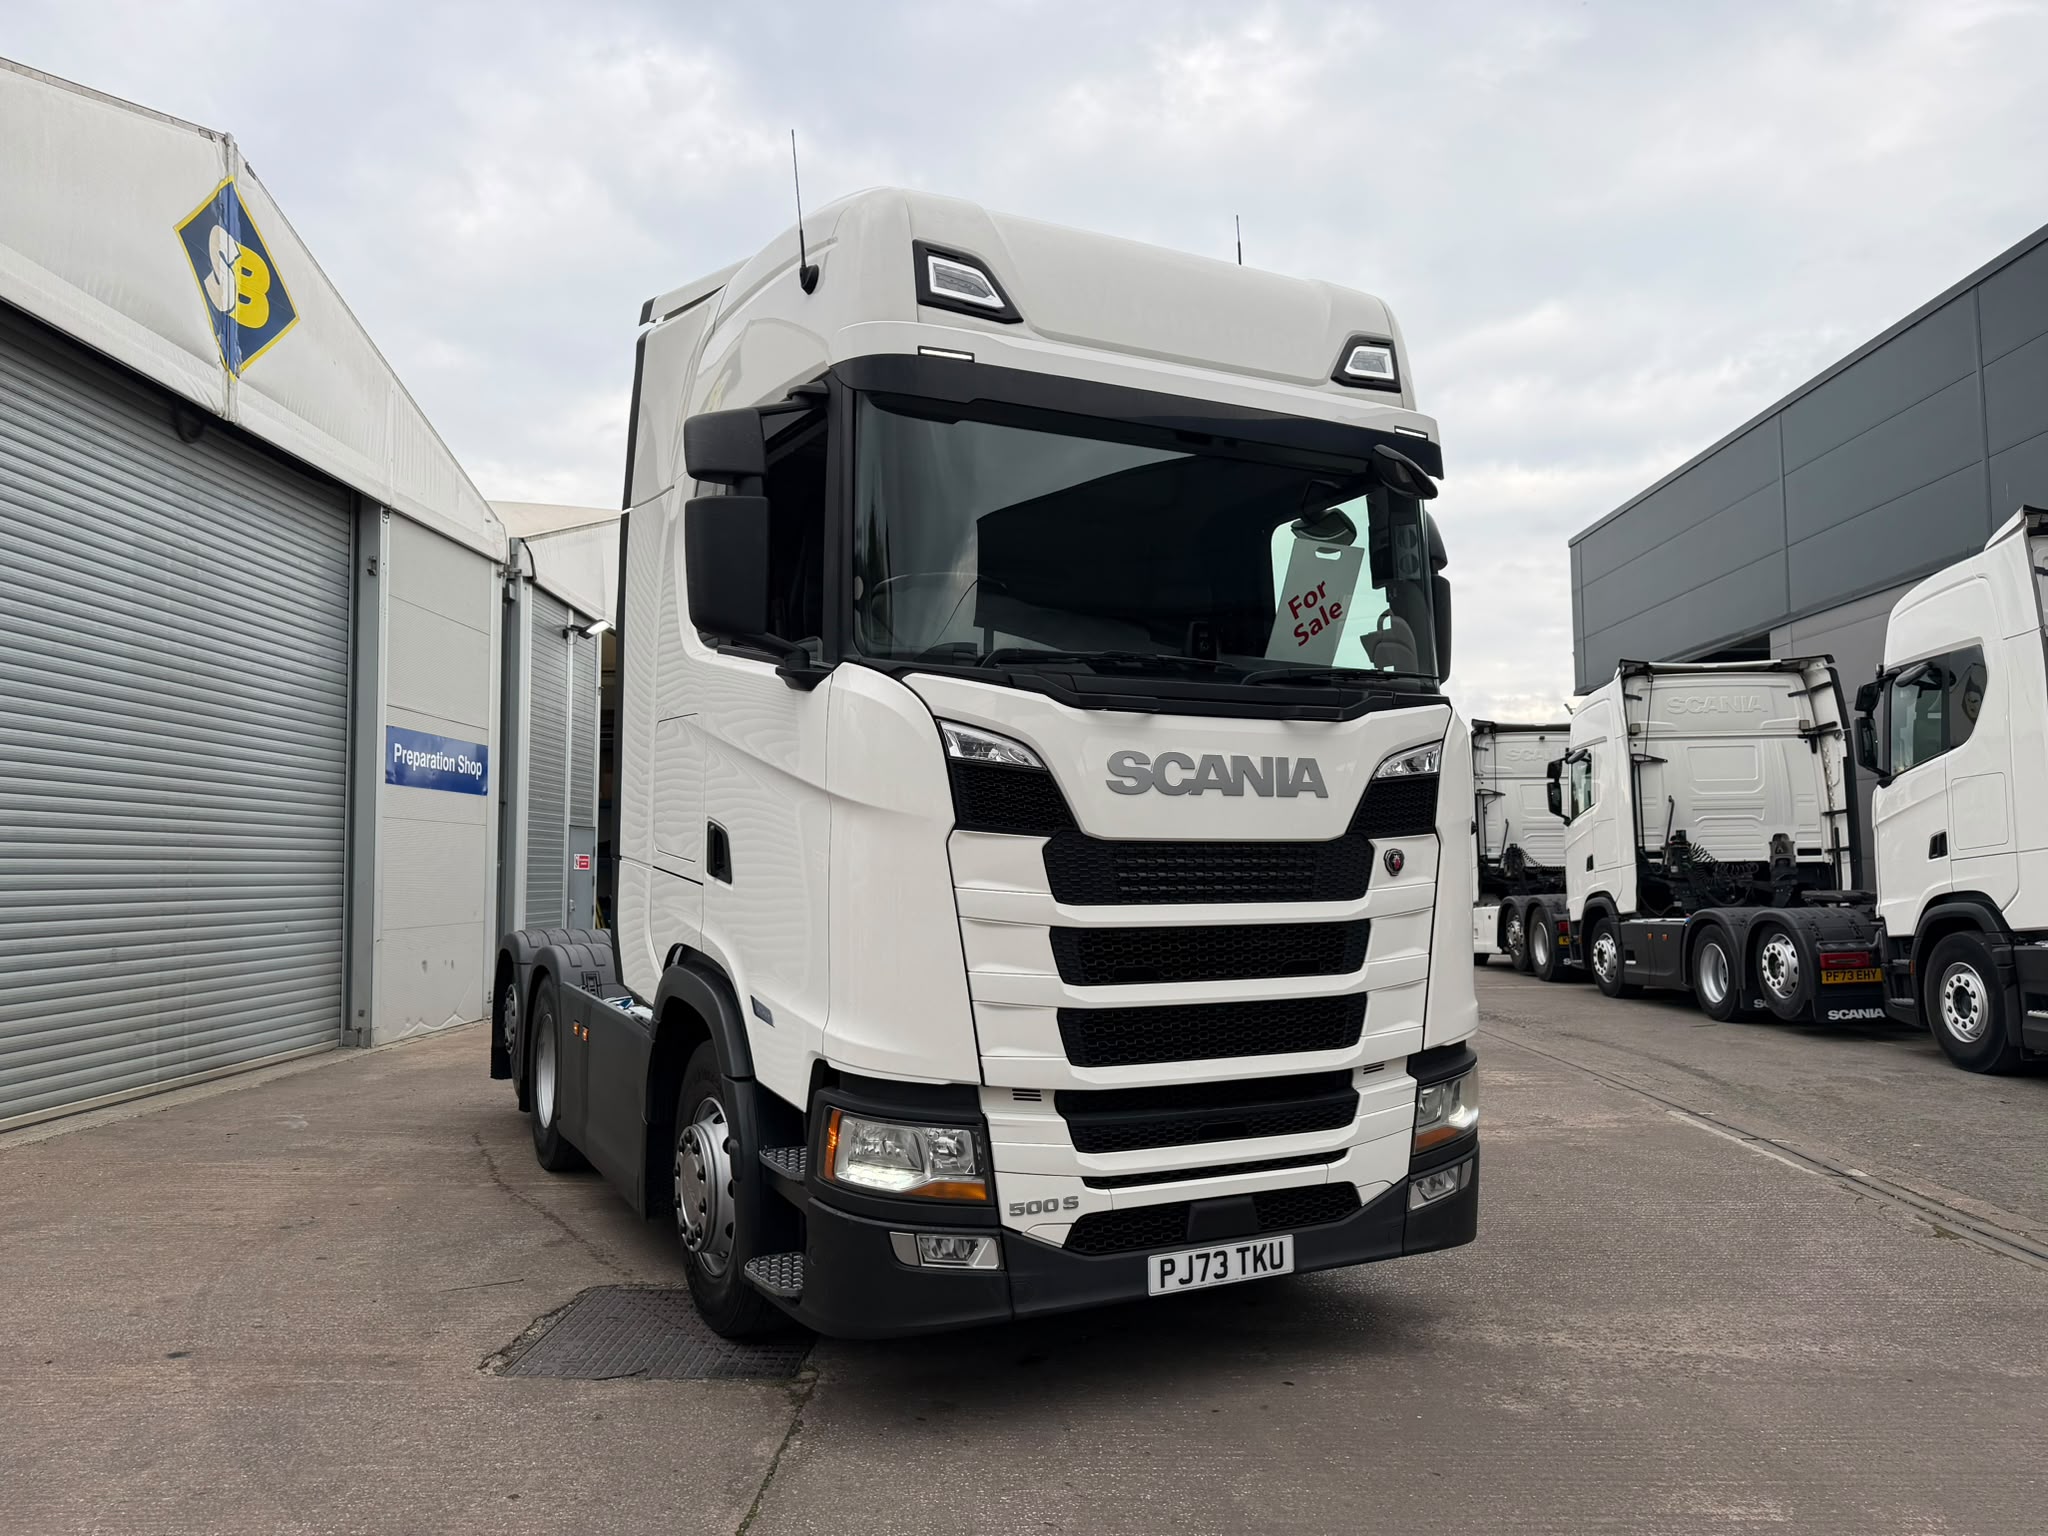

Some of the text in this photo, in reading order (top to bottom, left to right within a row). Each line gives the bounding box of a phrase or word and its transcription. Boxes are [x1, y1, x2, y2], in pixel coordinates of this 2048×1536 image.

[1288, 581, 1326, 620] For
[1294, 602, 1343, 646] Sale
[1667, 695, 1769, 714] SCANIA
[393, 743, 482, 781] Preparation Shop
[1105, 750, 1328, 798] SCANIA
[1825, 970, 1877, 981] PF73 EHY
[1827, 1008, 1886, 1020] SCANIA
[1009, 1195, 1079, 1217] 500 S
[1159, 1240, 1285, 1289] PJ73 TKU
